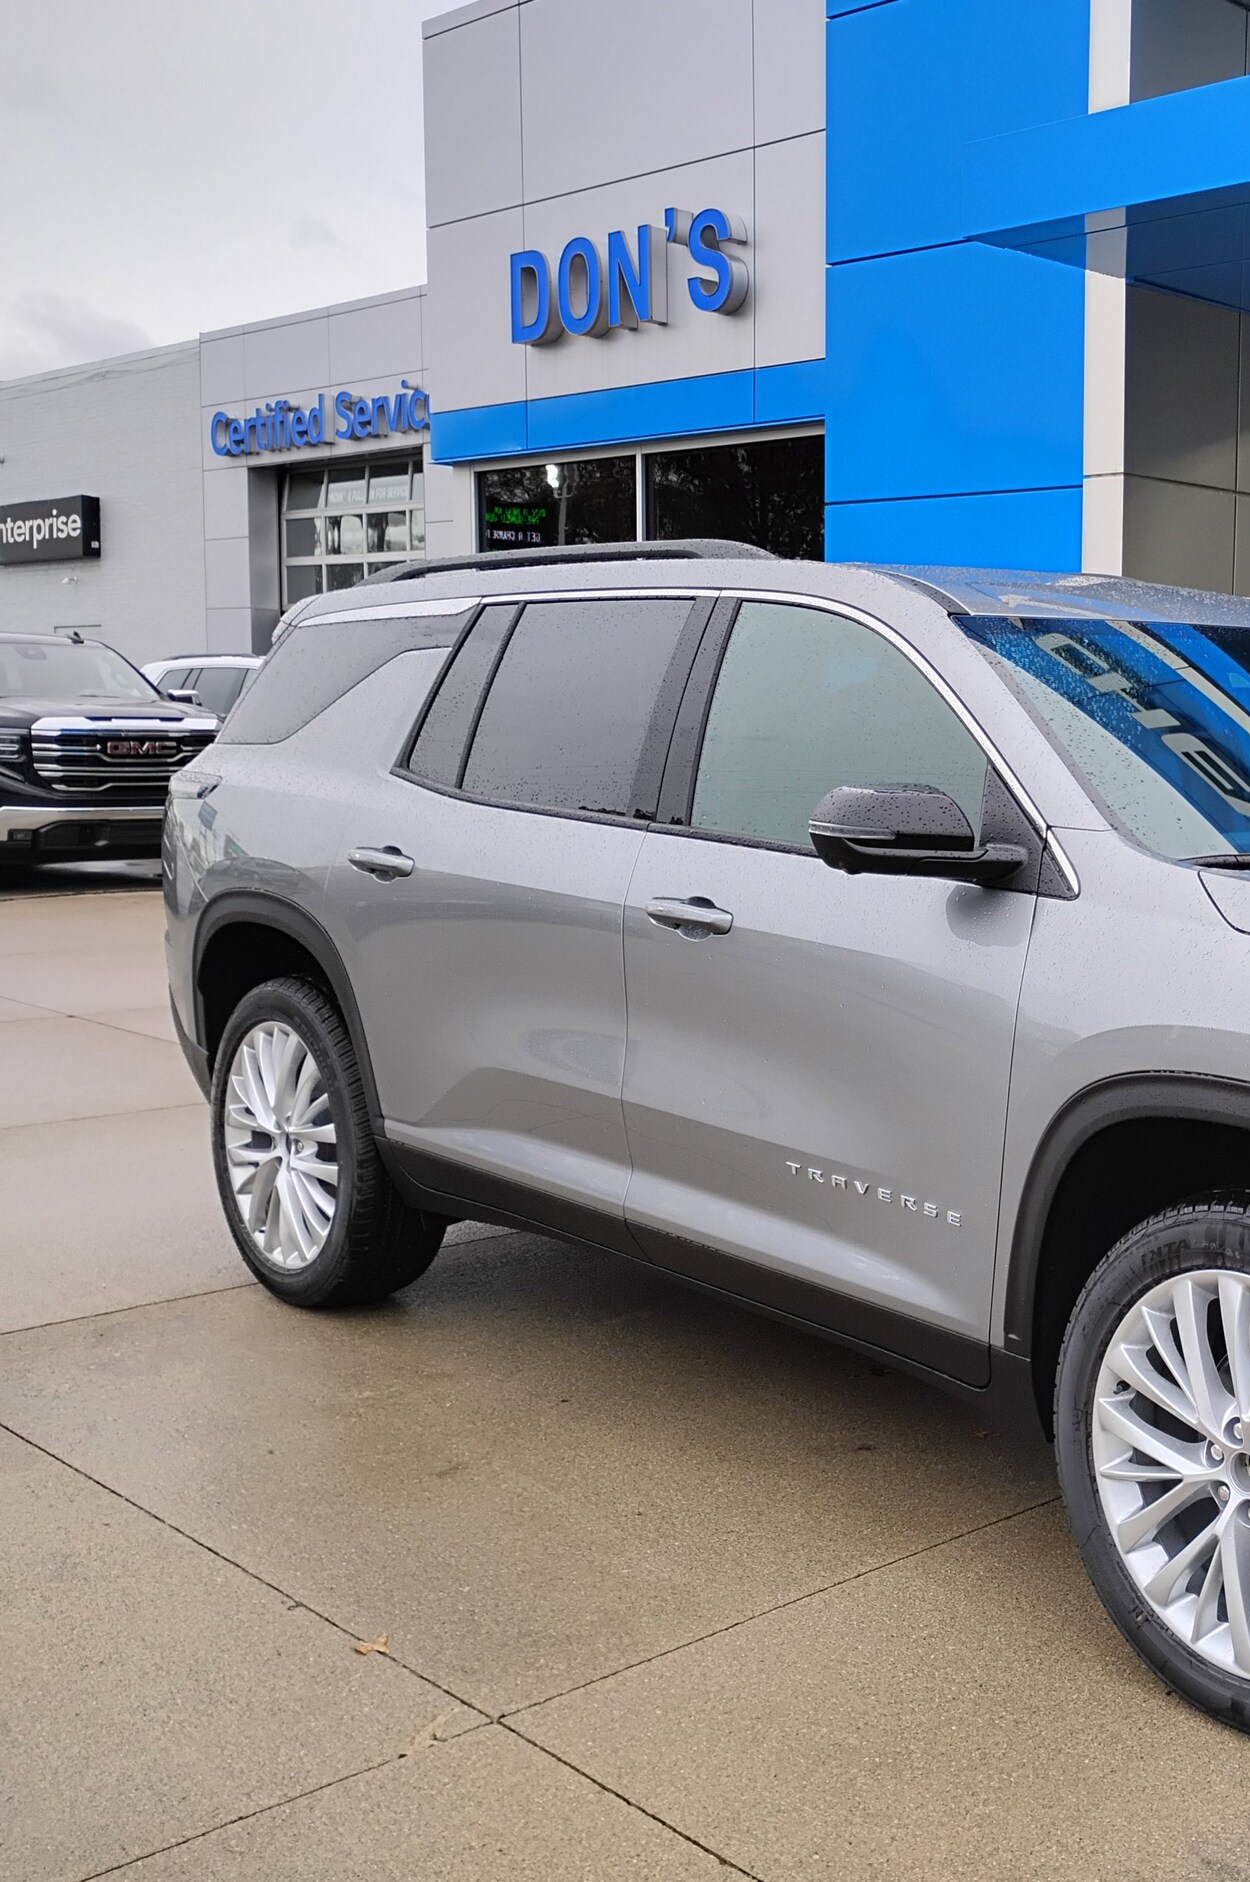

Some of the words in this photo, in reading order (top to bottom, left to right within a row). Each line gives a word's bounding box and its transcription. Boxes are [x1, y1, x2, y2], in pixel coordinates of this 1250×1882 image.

[510, 207, 742, 345] DON'S
[211, 393, 325, 456] Certified
[335, 379, 431, 440] Servic
[107, 741, 177, 755] GMC
[786, 1161, 962, 1227] TRAVERSE
